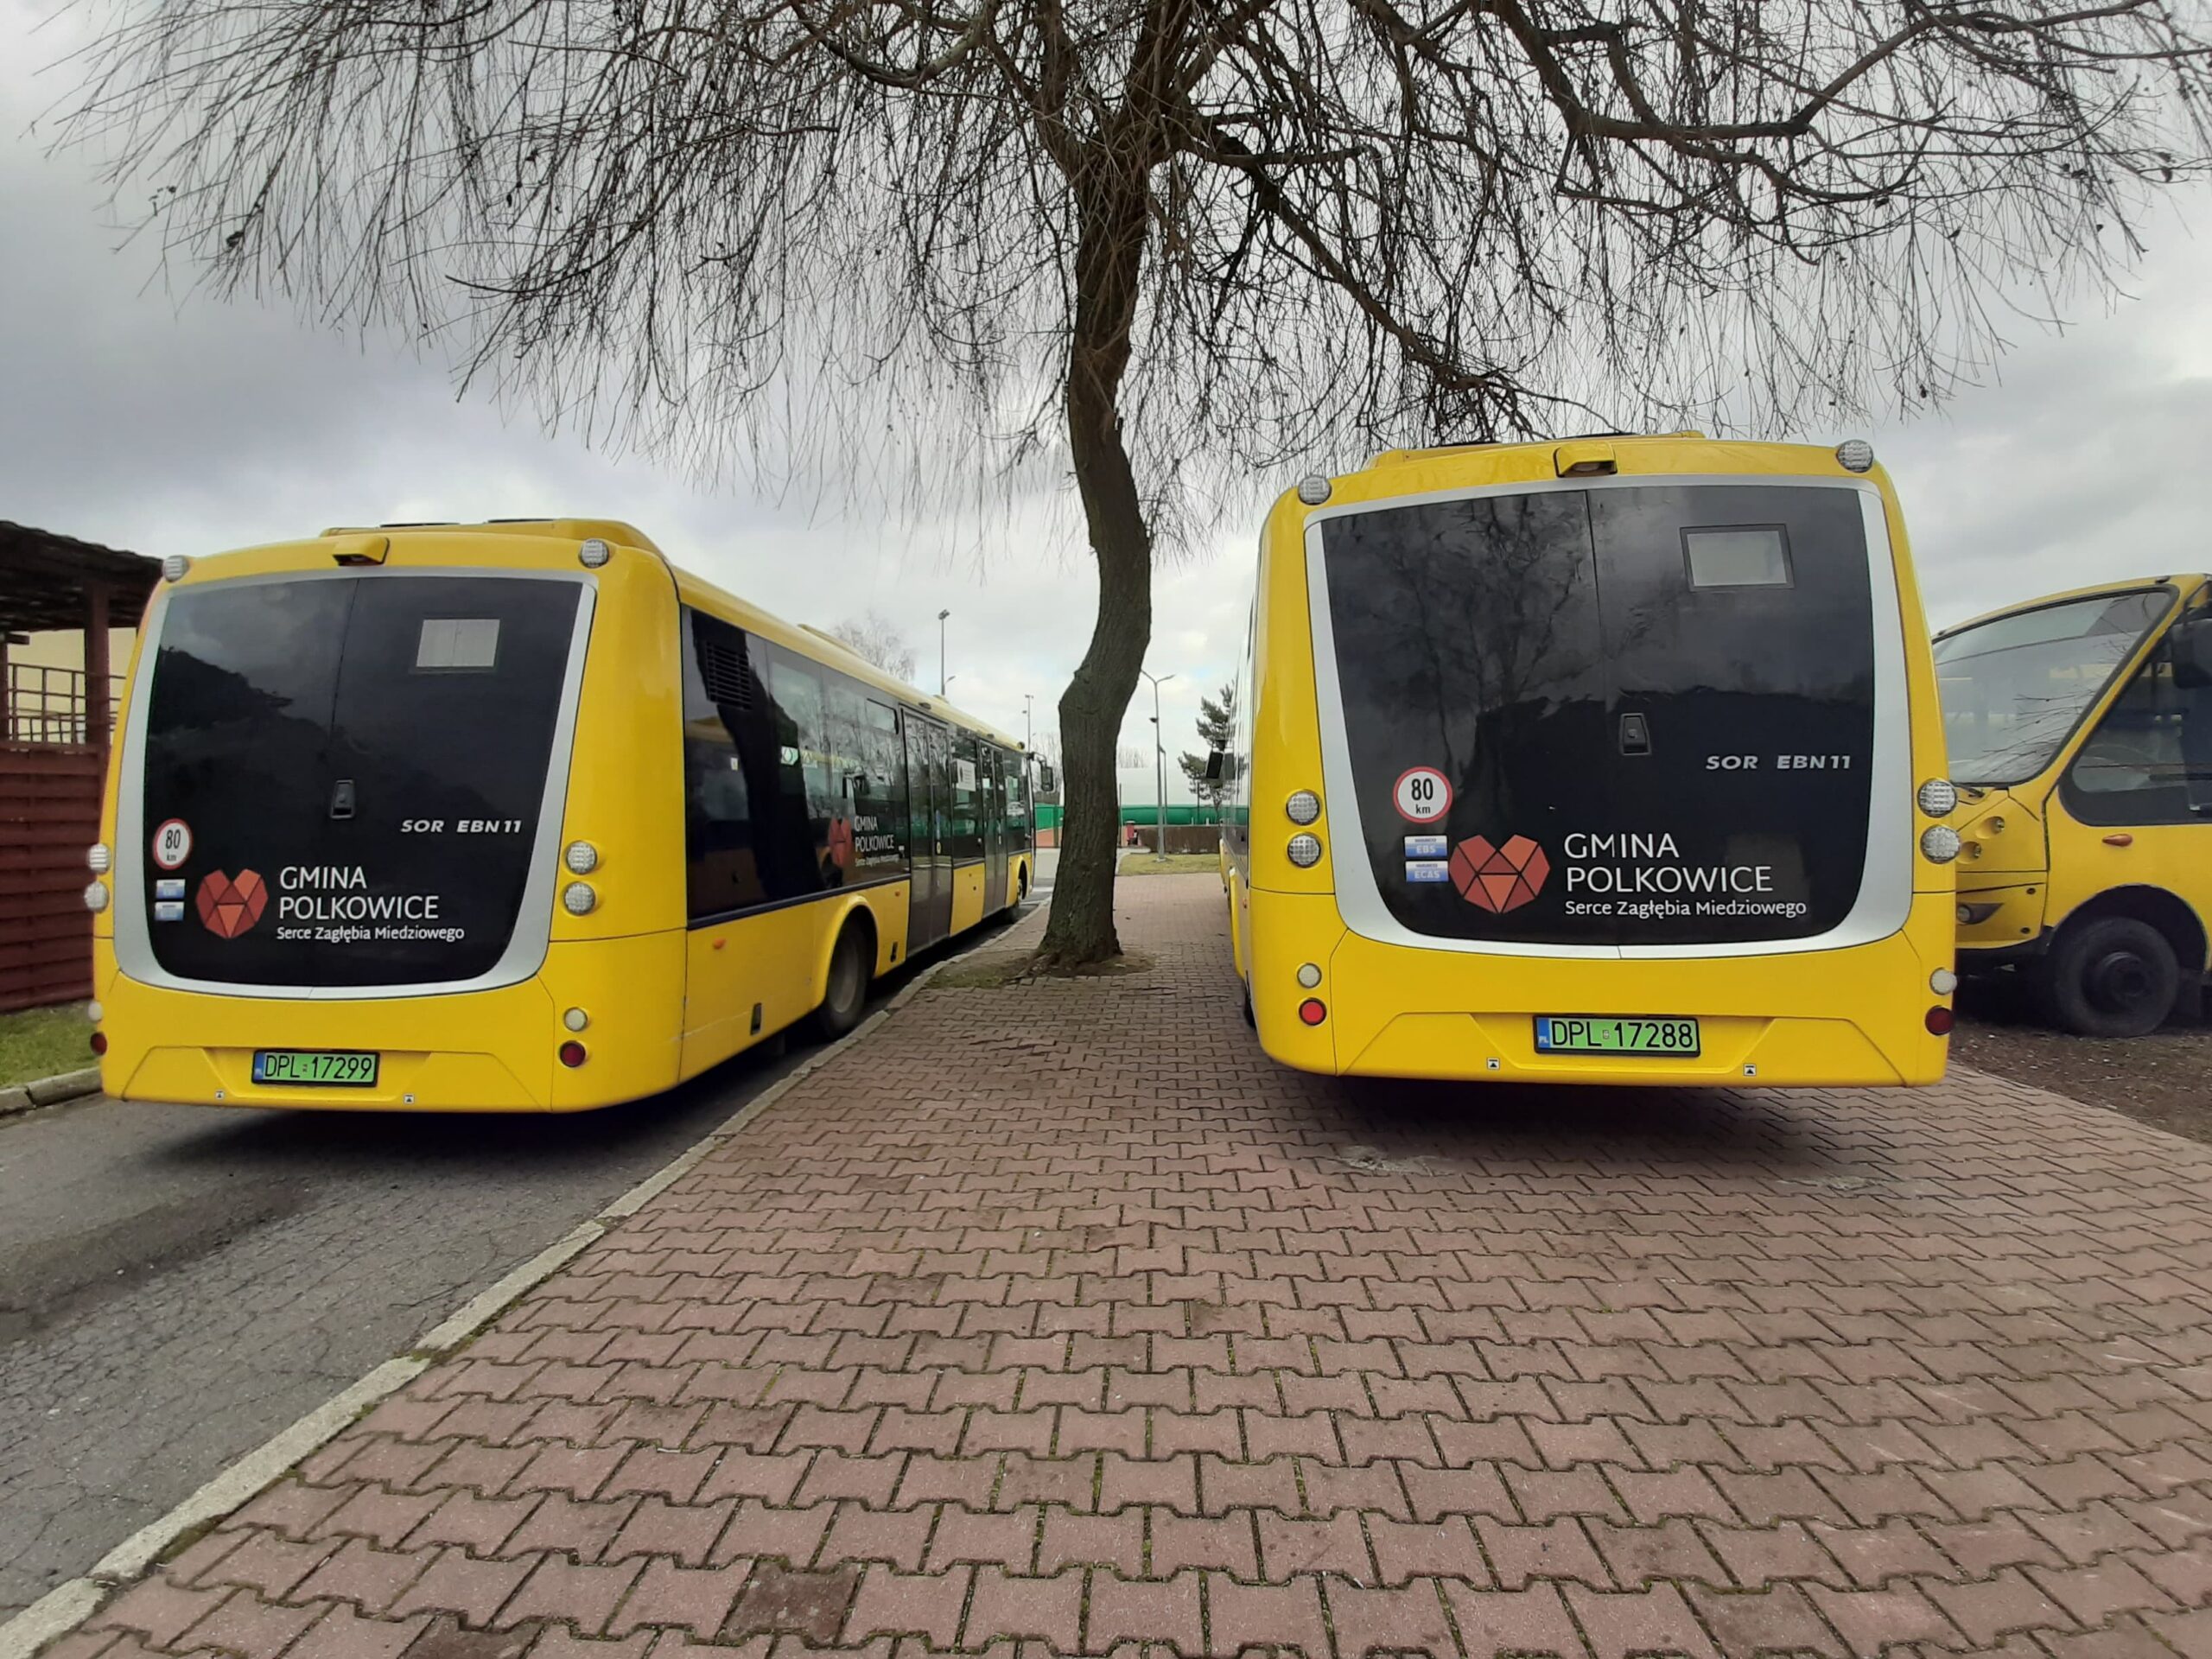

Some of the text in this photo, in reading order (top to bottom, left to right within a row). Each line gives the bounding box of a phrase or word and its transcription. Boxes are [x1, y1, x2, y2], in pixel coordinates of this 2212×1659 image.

[1706, 755, 1758, 770] SOR
[1411, 778, 1433, 800] 80
[1415, 804, 1431, 814] km
[401, 819, 444, 833] SOR
[855, 816, 879, 831] GMINA
[165, 829, 181, 849] 80
[855, 835, 894, 852] POLKOWICE
[1563, 832, 1680, 859] GMINA
[1416, 845, 1436, 855] EBS
[279, 866, 368, 890] GMINA
[1414, 870, 1440, 880] ECAS
[1566, 866, 1774, 893] POLKOWICE
[278, 895, 440, 920] POLKOWICE
[1565, 899, 1808, 919] Serce Zagłębia Miedziowego
[276, 925, 466, 944] Serce Zagłębia Miedziowego
[1552, 1020, 1602, 1046] DPL
[1614, 1021, 1694, 1048] 17288
[264, 1055, 373, 1079] DPL 17299
